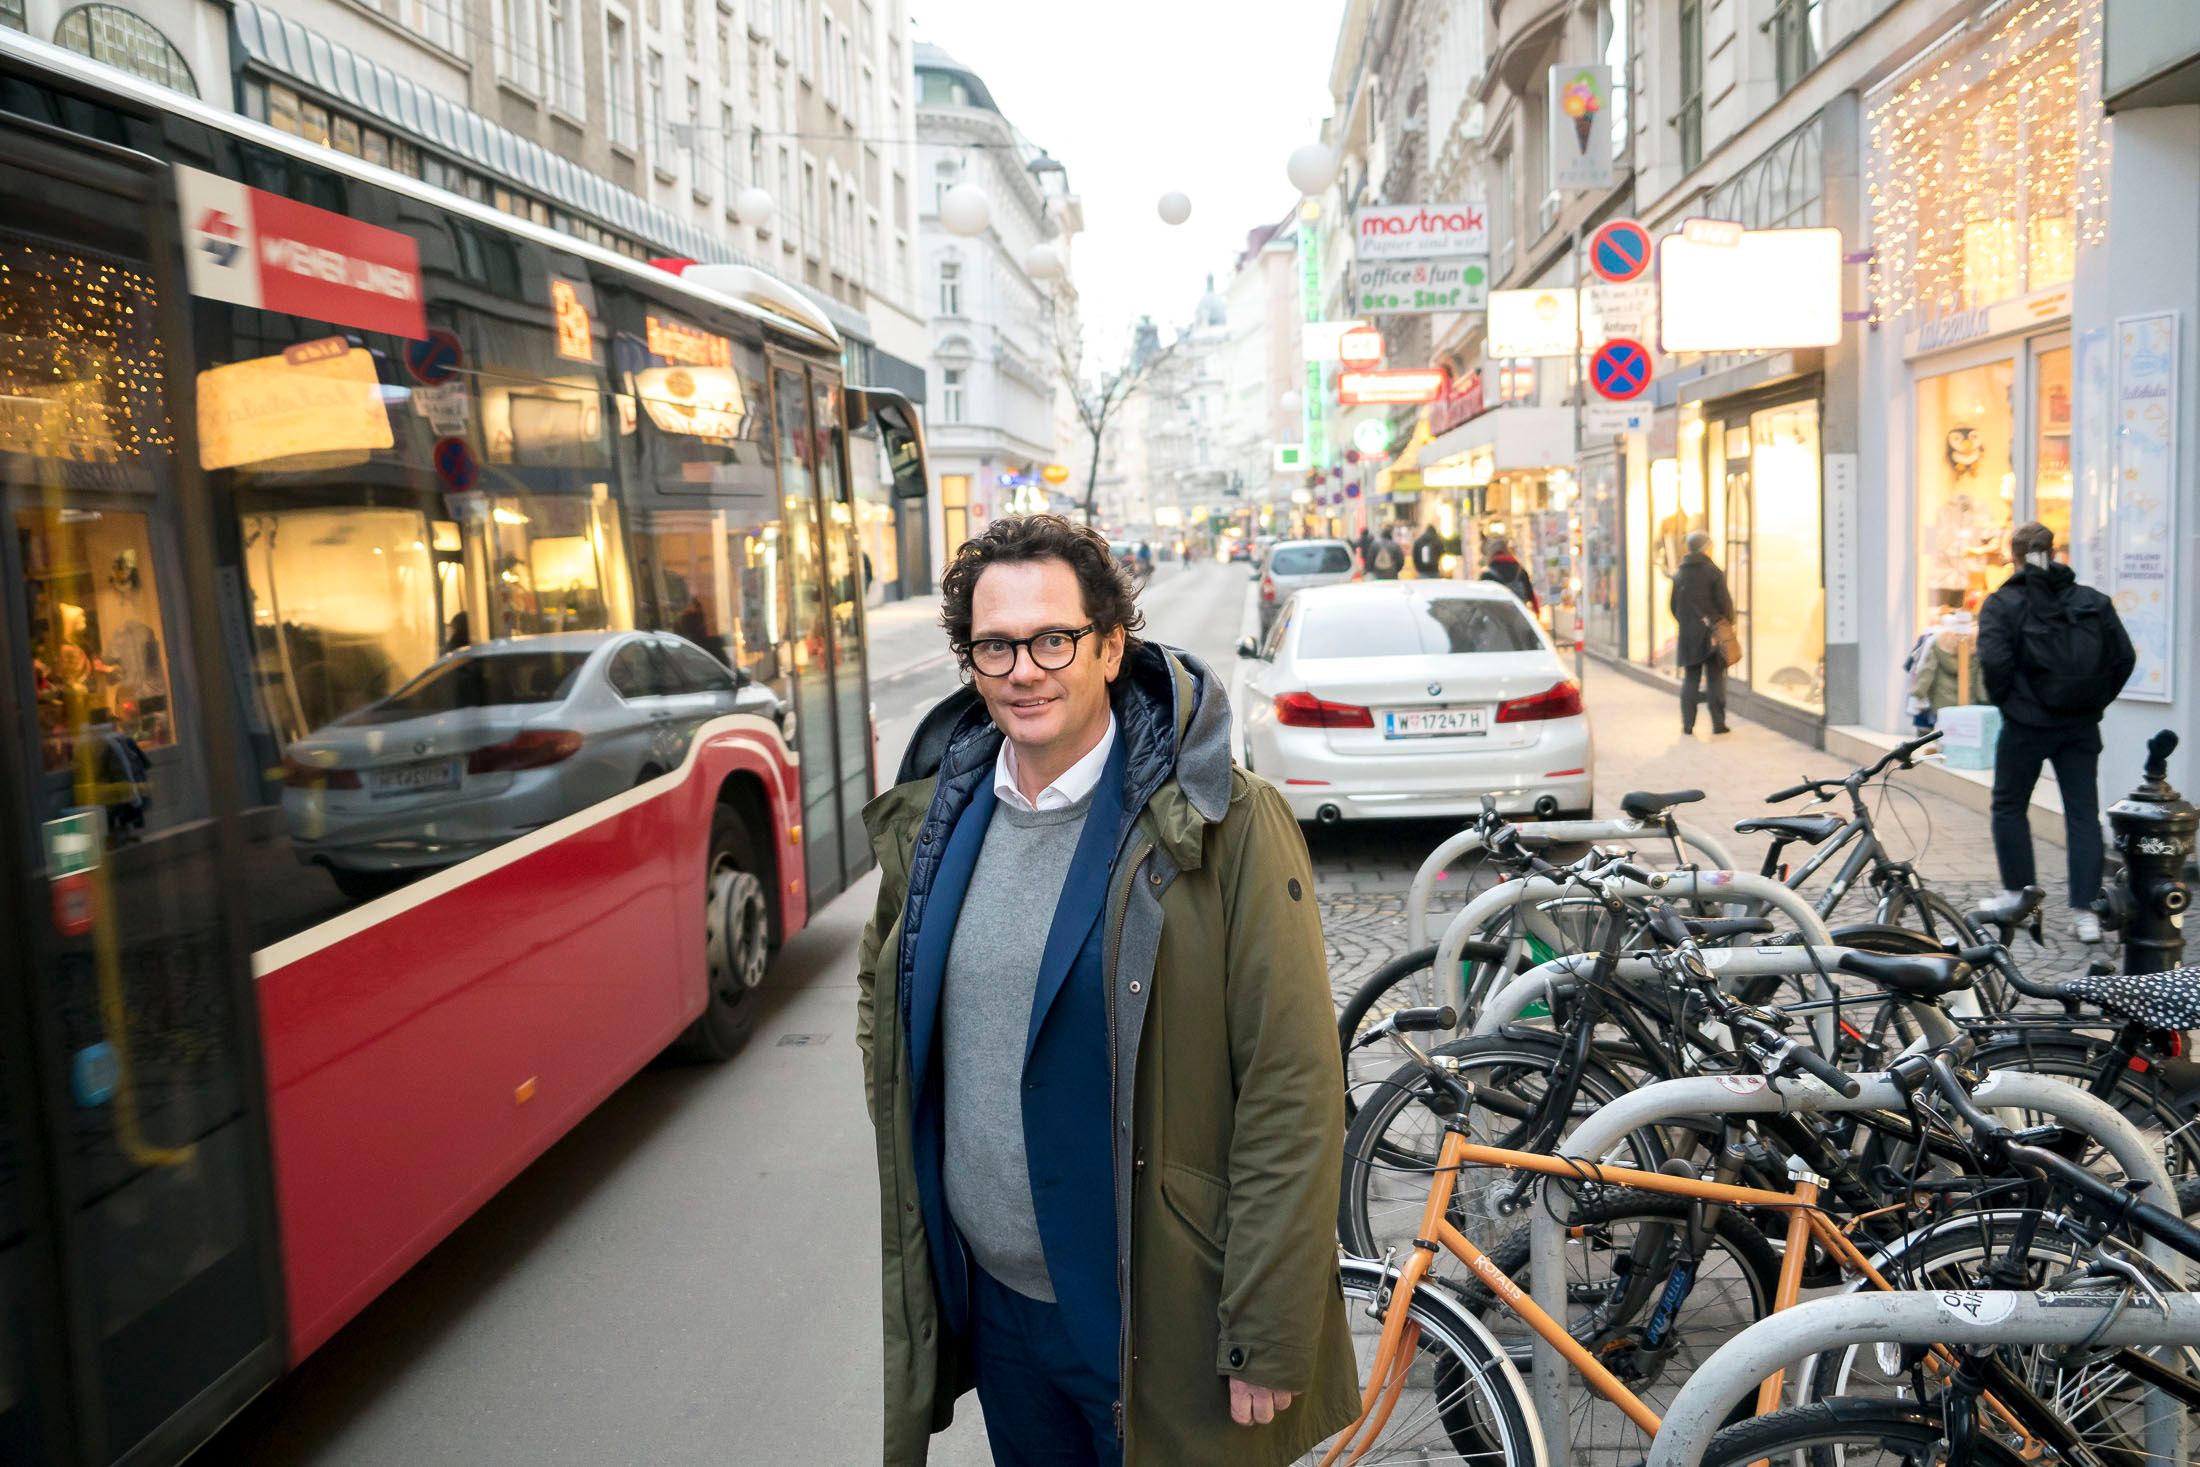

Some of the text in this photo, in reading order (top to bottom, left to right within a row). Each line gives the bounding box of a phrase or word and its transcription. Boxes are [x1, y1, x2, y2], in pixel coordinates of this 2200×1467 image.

[1362, 207, 1484, 236] mastnak
[1422, 713, 1466, 729] 17247
[1473, 1254, 1521, 1301] ROTALIS
